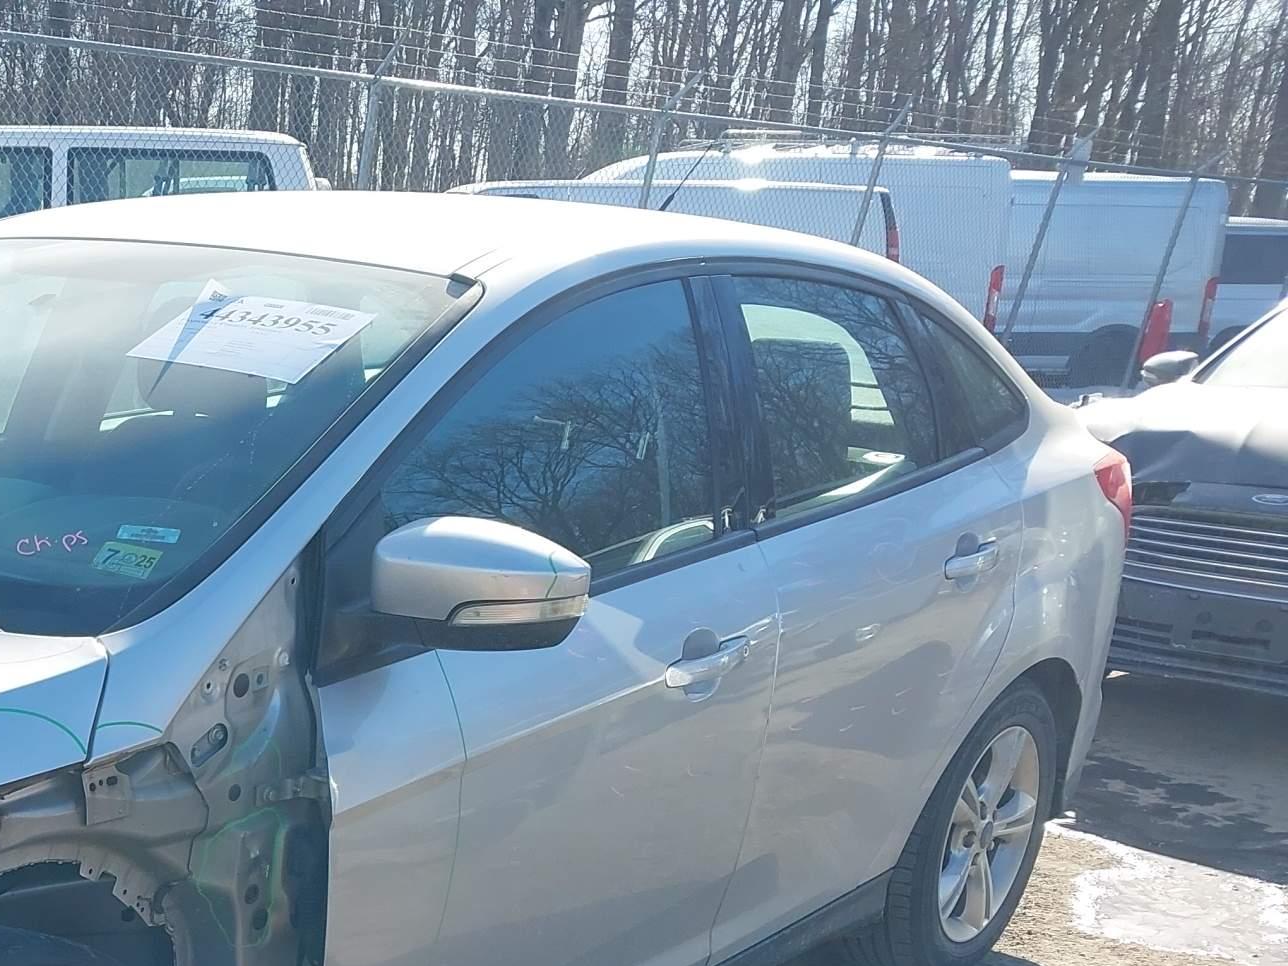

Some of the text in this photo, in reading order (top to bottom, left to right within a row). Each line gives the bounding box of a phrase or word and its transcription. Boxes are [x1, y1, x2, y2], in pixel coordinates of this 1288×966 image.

[199, 307, 337, 337] 44343955
[102, 547, 157, 569] 7 25
